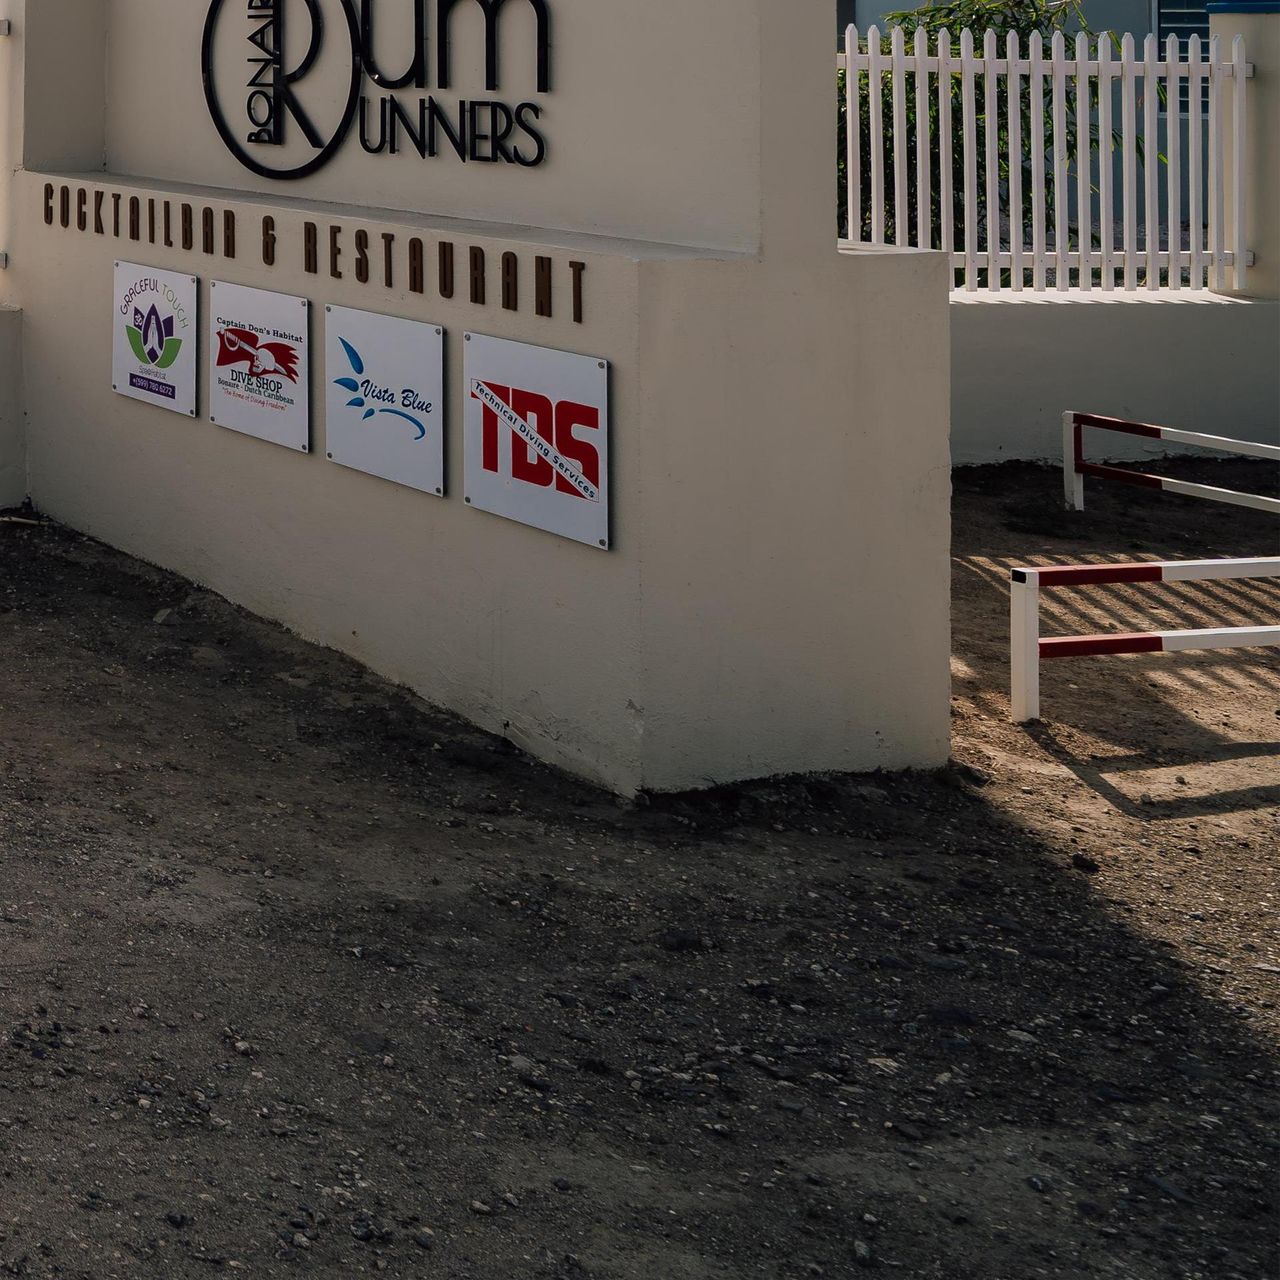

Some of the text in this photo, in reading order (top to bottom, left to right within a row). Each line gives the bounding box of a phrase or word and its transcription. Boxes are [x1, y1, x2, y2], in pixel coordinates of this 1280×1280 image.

[43, 183, 586, 324] COCKTAILBAR & RESTAURANT
[120, 278, 189, 329] GRACEFUL TOUCH
[216, 316, 304, 343] Captain Don's Habitat
[230, 369, 283, 394] DIVE SHOP
[244, 385, 262, 397] Dutch
[263, 390, 295, 405] Caribbean
[361, 379, 433, 413] Vista Blue
[471, 380, 599, 500] TDS
[475, 381, 596, 499] Technical Diving Services
